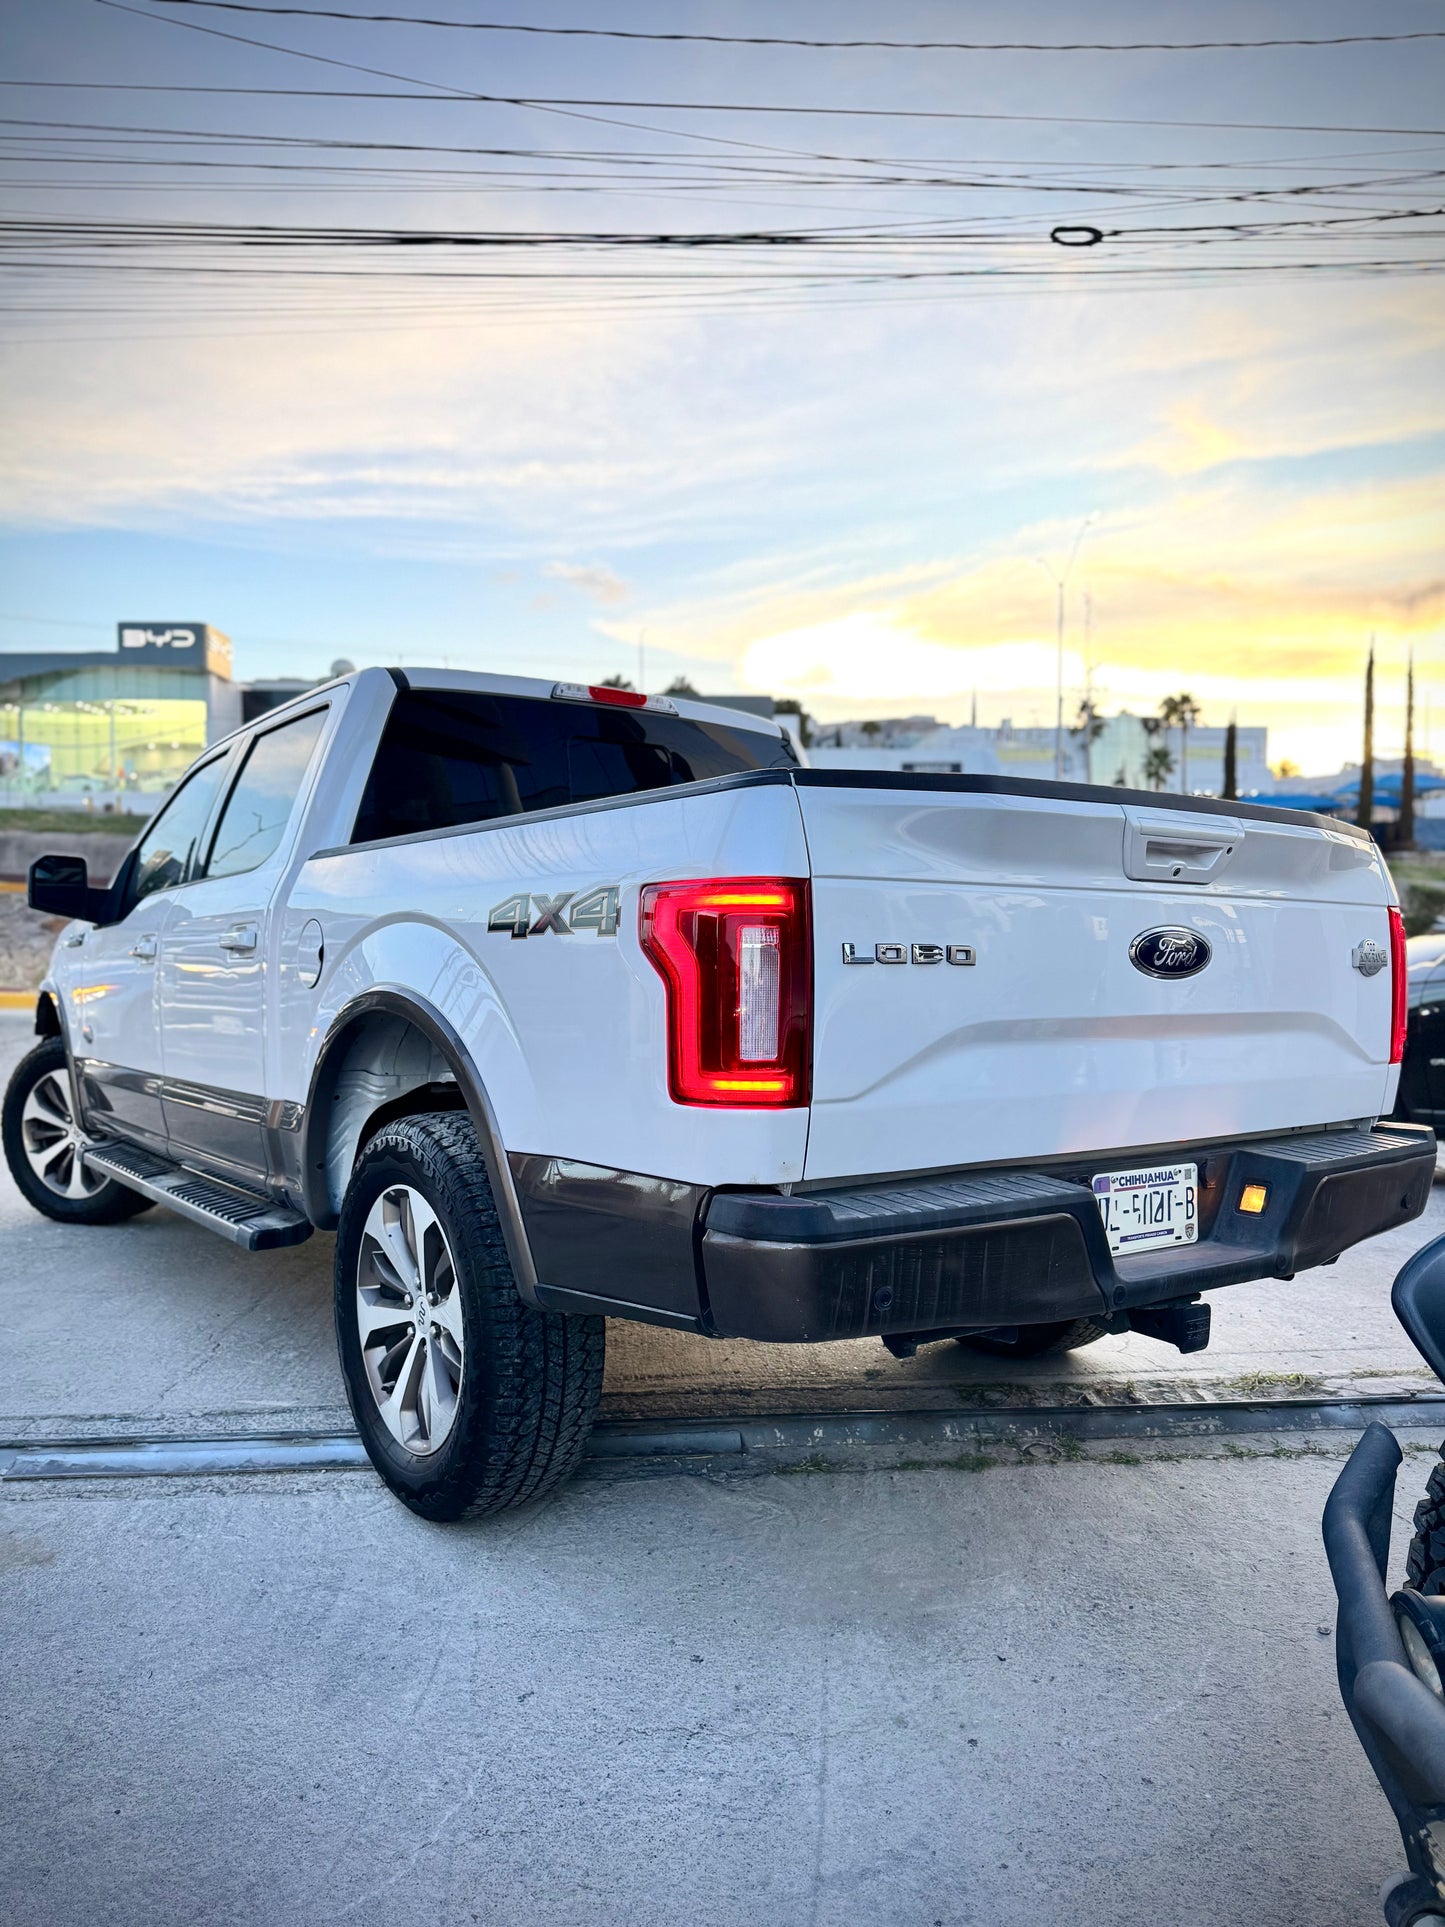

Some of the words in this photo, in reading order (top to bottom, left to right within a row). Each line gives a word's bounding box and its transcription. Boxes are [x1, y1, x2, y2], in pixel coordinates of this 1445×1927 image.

[122, 629, 195, 648] BYD
[842, 943, 976, 966] LOBO
[1153, 937, 1197, 967] Ford
[1118, 1170, 1175, 1187] CHIHUAHUA
